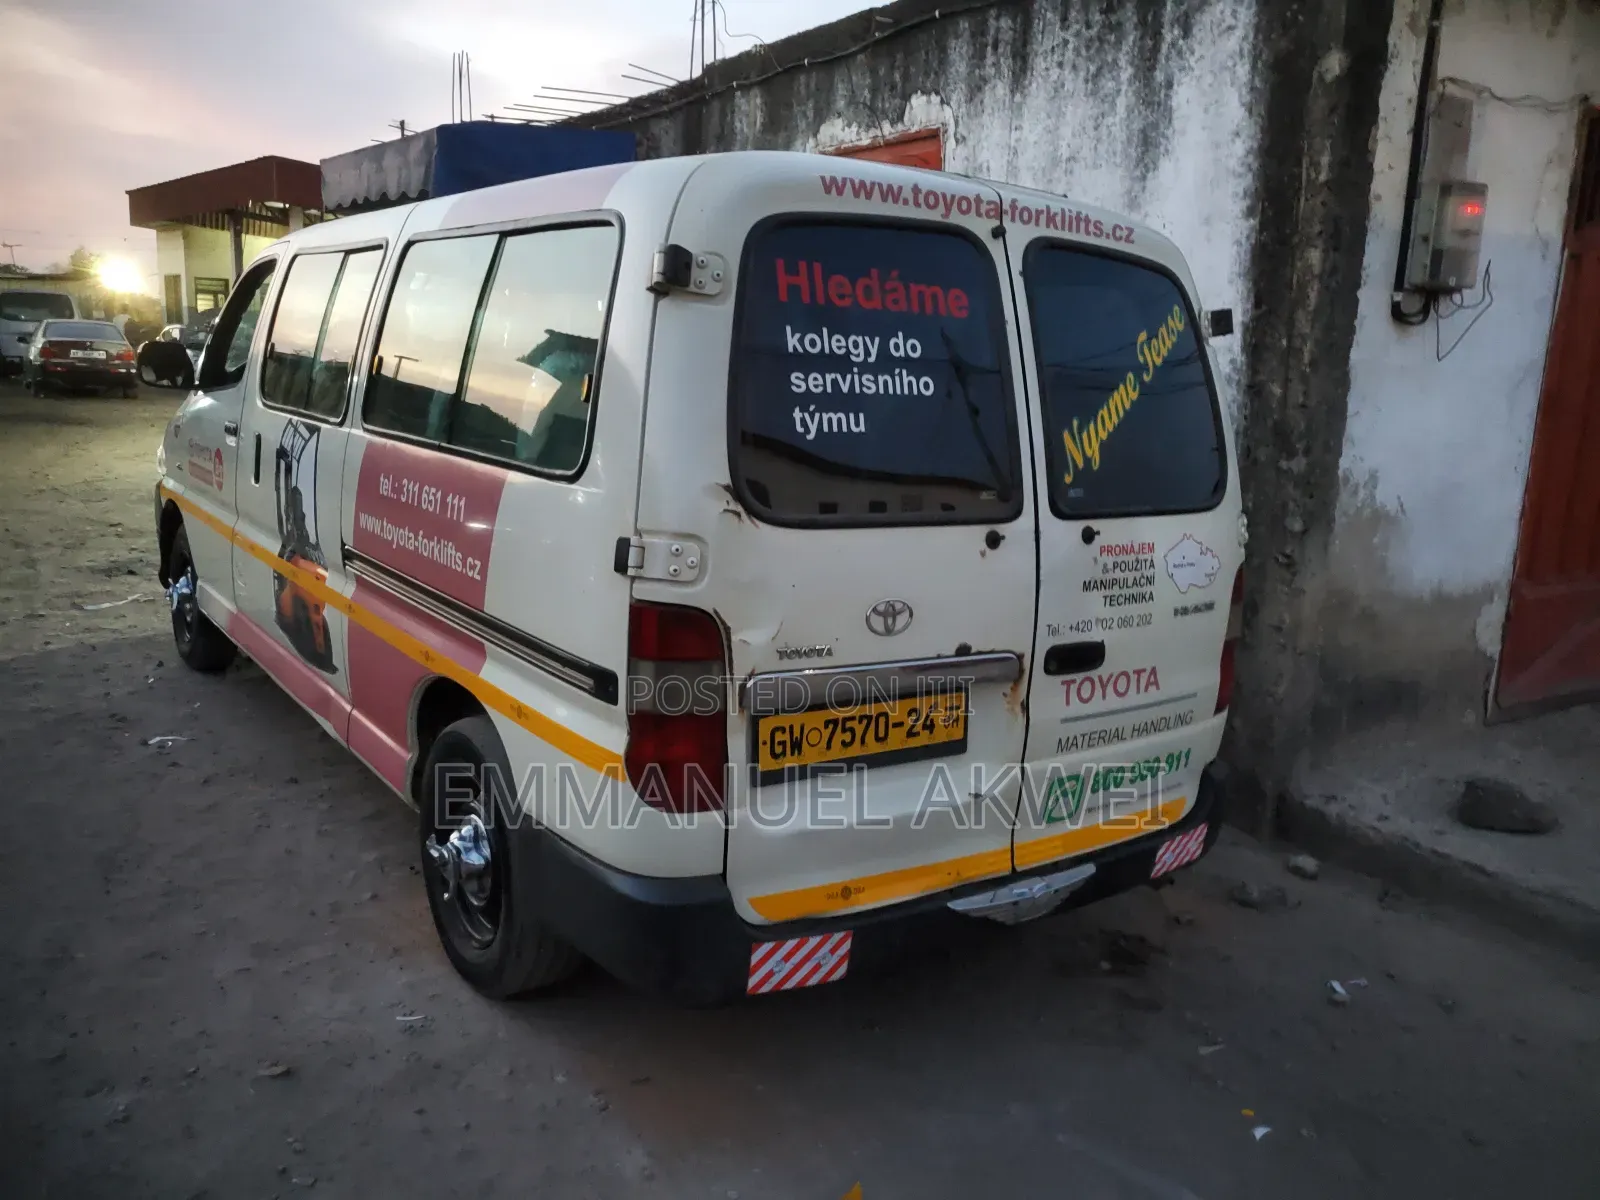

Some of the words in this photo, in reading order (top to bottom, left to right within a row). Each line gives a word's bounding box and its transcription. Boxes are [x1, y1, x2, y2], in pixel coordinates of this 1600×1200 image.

[819, 175, 1135, 244] www.toyota-forklifts.cz
[775, 258, 969, 318] Hledáme
[785, 325, 879, 363] kolegy
[889, 331, 922, 358] do
[790, 367, 935, 396] servisního
[793, 405, 865, 440] týmu
[1063, 371, 1140, 484] Nyame
[380, 473, 398, 499] tel.:
[401, 478, 419, 506] 311
[421, 485, 441, 514] 651
[447, 493, 465, 522] 111
[359, 512, 481, 580] www.toyota-forklifts.cz
[1100, 542, 1155, 557] PRONÁJEM
[1082, 573, 1155, 592] MANIPULAČNÍ
[1102, 591, 1154, 607] TECHNIKA
[1046, 623, 1065, 637] Tel.:
[1069, 620, 1092, 633] +420
[1096, 617, 1113, 631] 02
[1136, 613, 1152, 627] 202
[776, 645, 833, 660] TOYOTA
[1061, 666, 1160, 707] TOYOTA
[769, 727, 805, 760] GW
[823, 702, 936, 751] 7570-24
[1056, 727, 1126, 754] MATERIAL
[1131, 710, 1194, 739] HANDLING
[1166, 747, 1191, 775] 911
